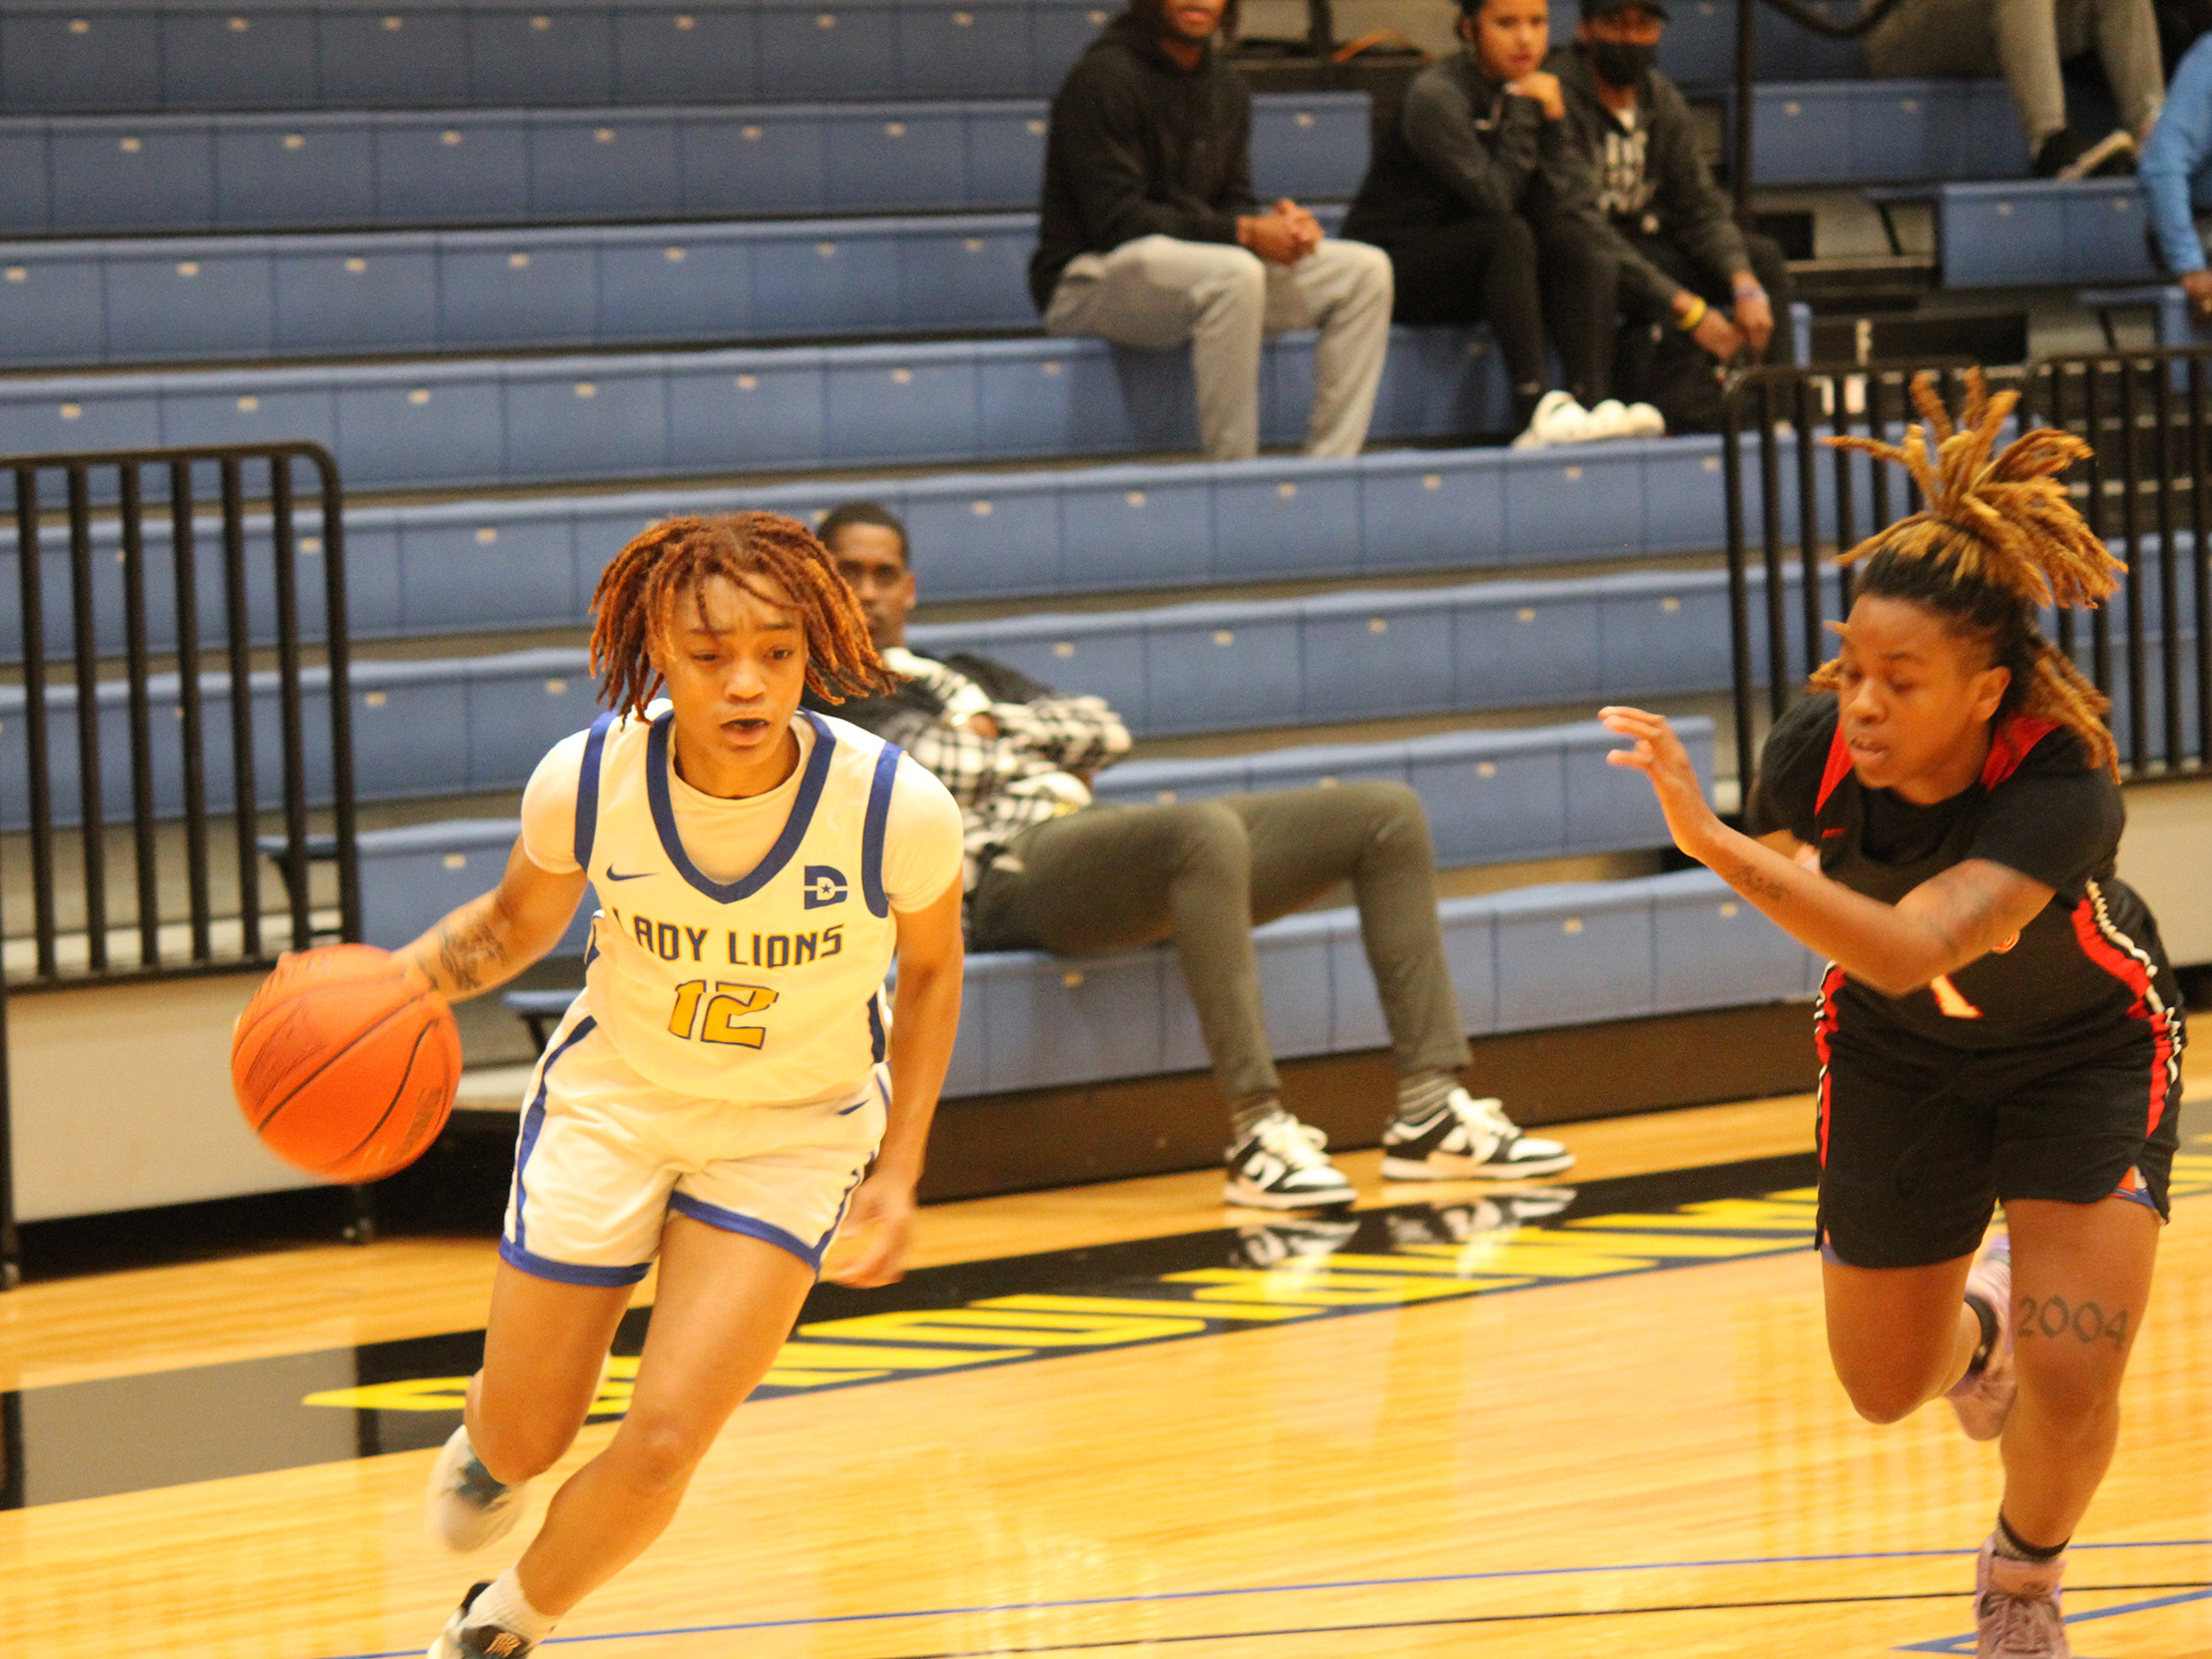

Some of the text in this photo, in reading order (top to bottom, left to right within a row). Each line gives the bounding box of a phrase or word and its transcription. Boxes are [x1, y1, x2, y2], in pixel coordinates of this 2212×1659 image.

[612, 906, 845, 969] ADY LIONS
[668, 978, 780, 1050] 12
[2016, 1295, 2128, 1351] 2004
